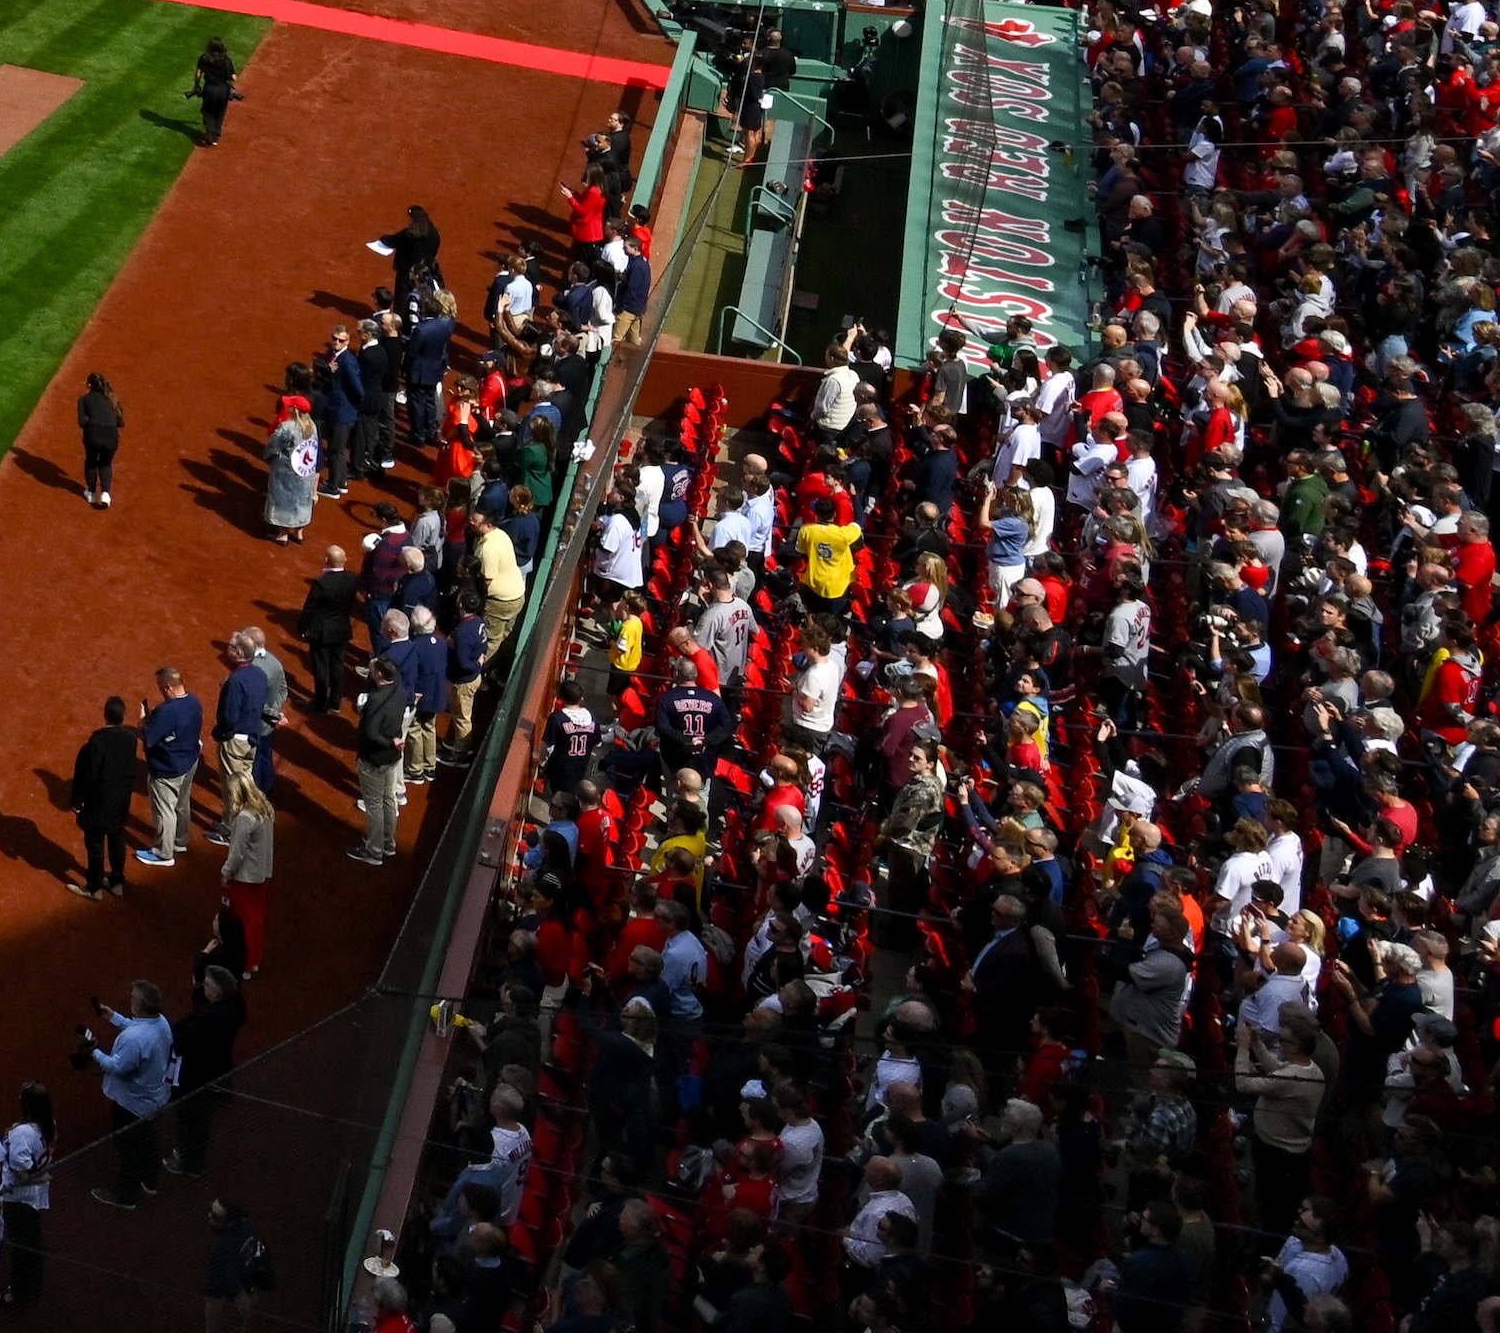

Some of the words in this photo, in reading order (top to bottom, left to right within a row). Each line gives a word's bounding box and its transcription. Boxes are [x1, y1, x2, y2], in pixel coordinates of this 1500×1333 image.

[944, 42, 1053, 122] SOX
[940, 117, 1051, 202] RED
[683, 713, 705, 736] 11
